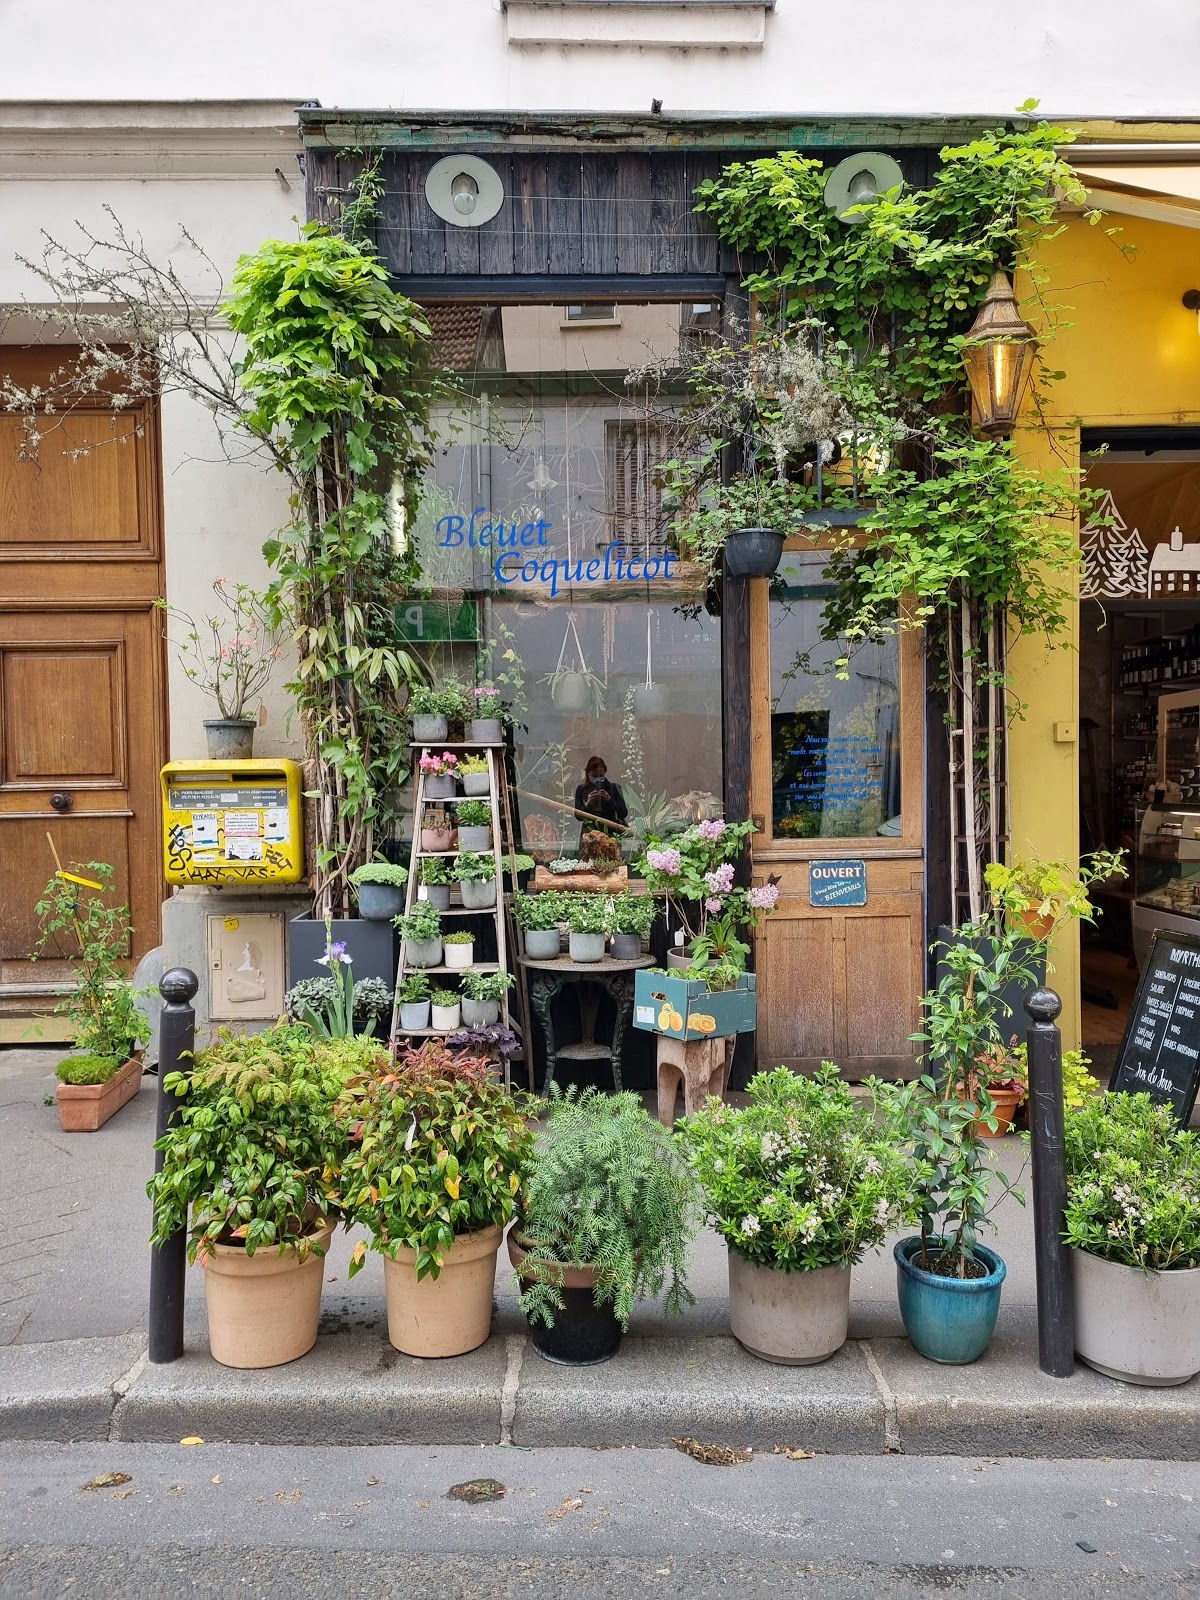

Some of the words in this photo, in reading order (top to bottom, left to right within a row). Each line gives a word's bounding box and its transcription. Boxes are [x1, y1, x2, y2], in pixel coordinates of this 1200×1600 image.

[435, 506, 553, 548] Bleuet
[494, 540, 678, 599] Coquelicot
[812, 867, 862, 878] OUVERT
[824, 882, 862, 902] BIENVENUS
[1175, 1006, 1195, 1018] FROMAGE
[1148, 1066, 1158, 1084] du
